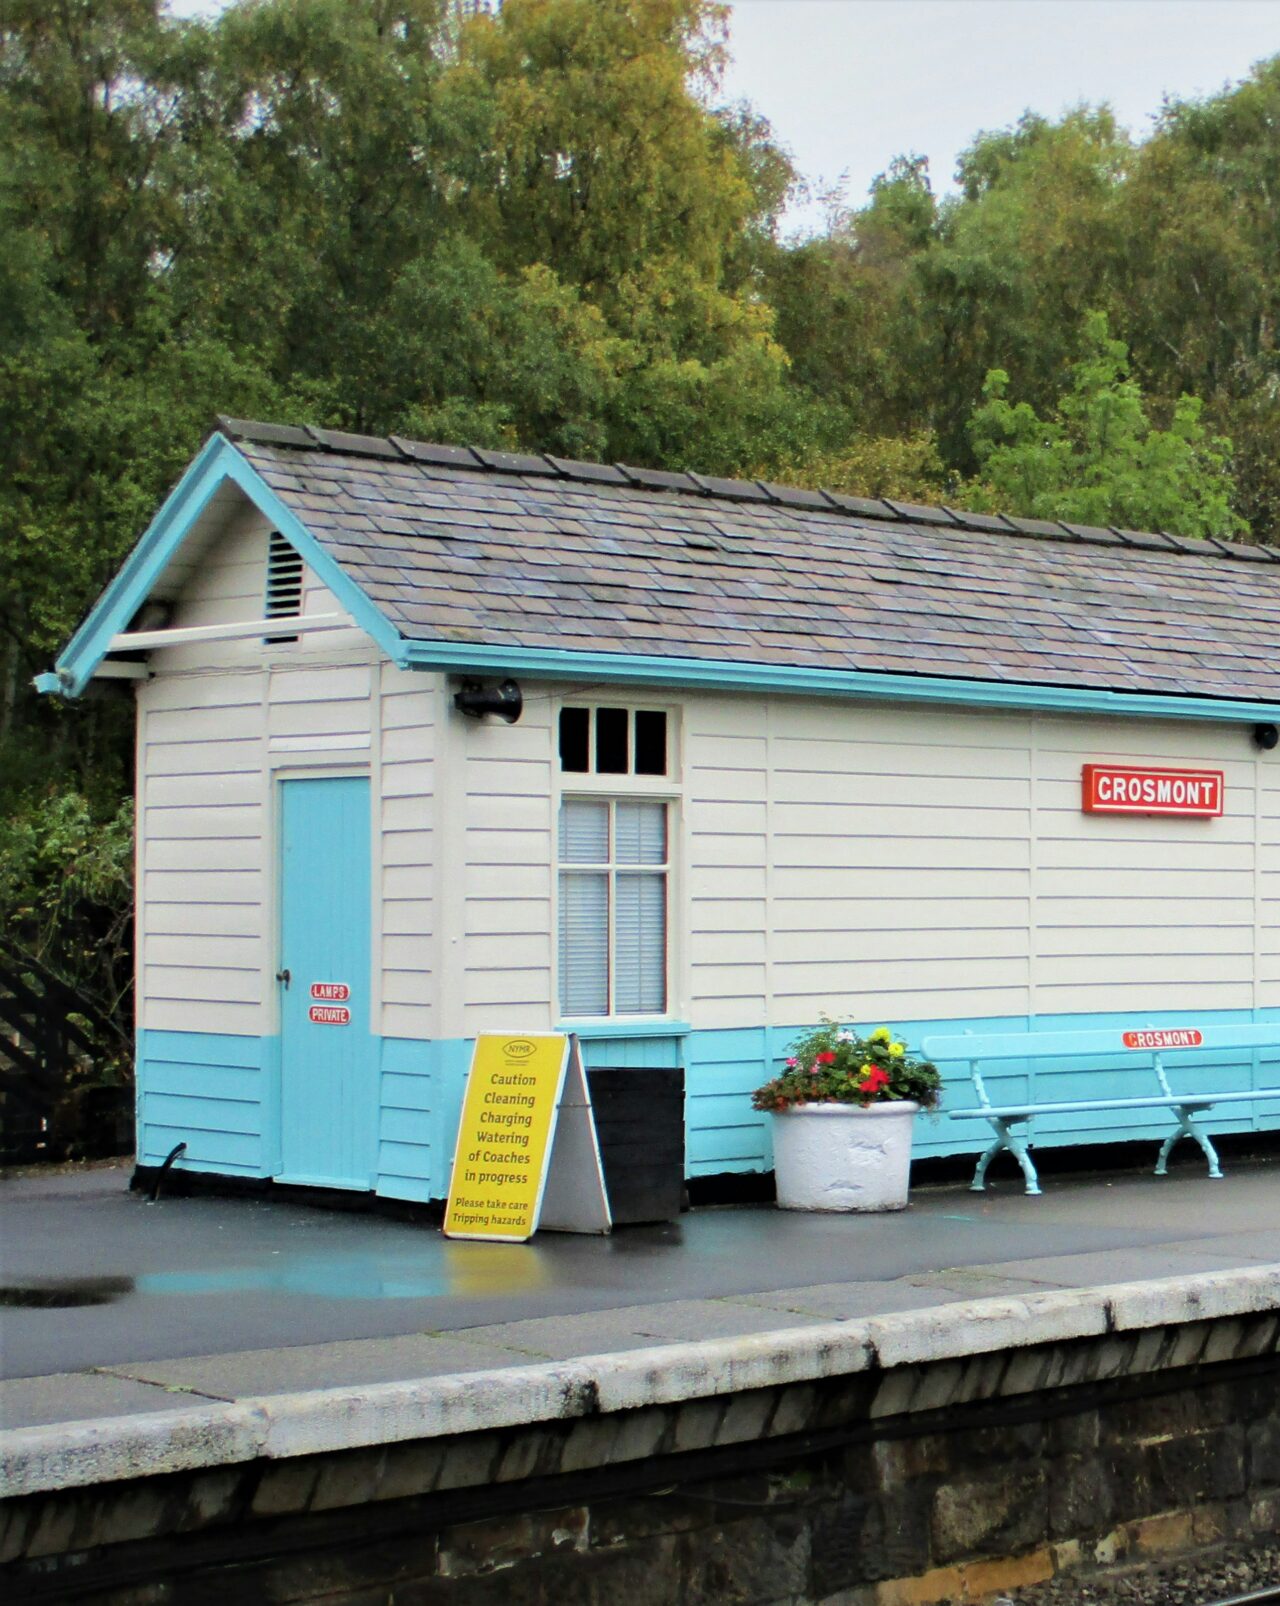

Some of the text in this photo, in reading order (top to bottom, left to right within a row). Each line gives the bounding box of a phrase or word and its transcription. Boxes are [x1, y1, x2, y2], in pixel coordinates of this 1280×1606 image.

[1098, 776, 1214, 805] GROSMONT
[314, 985, 345, 999] LAMPS
[312, 1007, 347, 1022] PRIVATE
[1129, 1031, 1196, 1047] GROSMONT
[491, 1073, 537, 1086] Caution
[484, 1092, 535, 1108] Cleaning
[480, 1111, 532, 1128] Charging
[477, 1131, 529, 1147] Watering
[468, 1150, 531, 1164] of Coaches
[464, 1169, 528, 1186] in progress
[455, 1197, 529, 1210] Please take care
[453, 1212, 526, 1226] Tripping hazards
